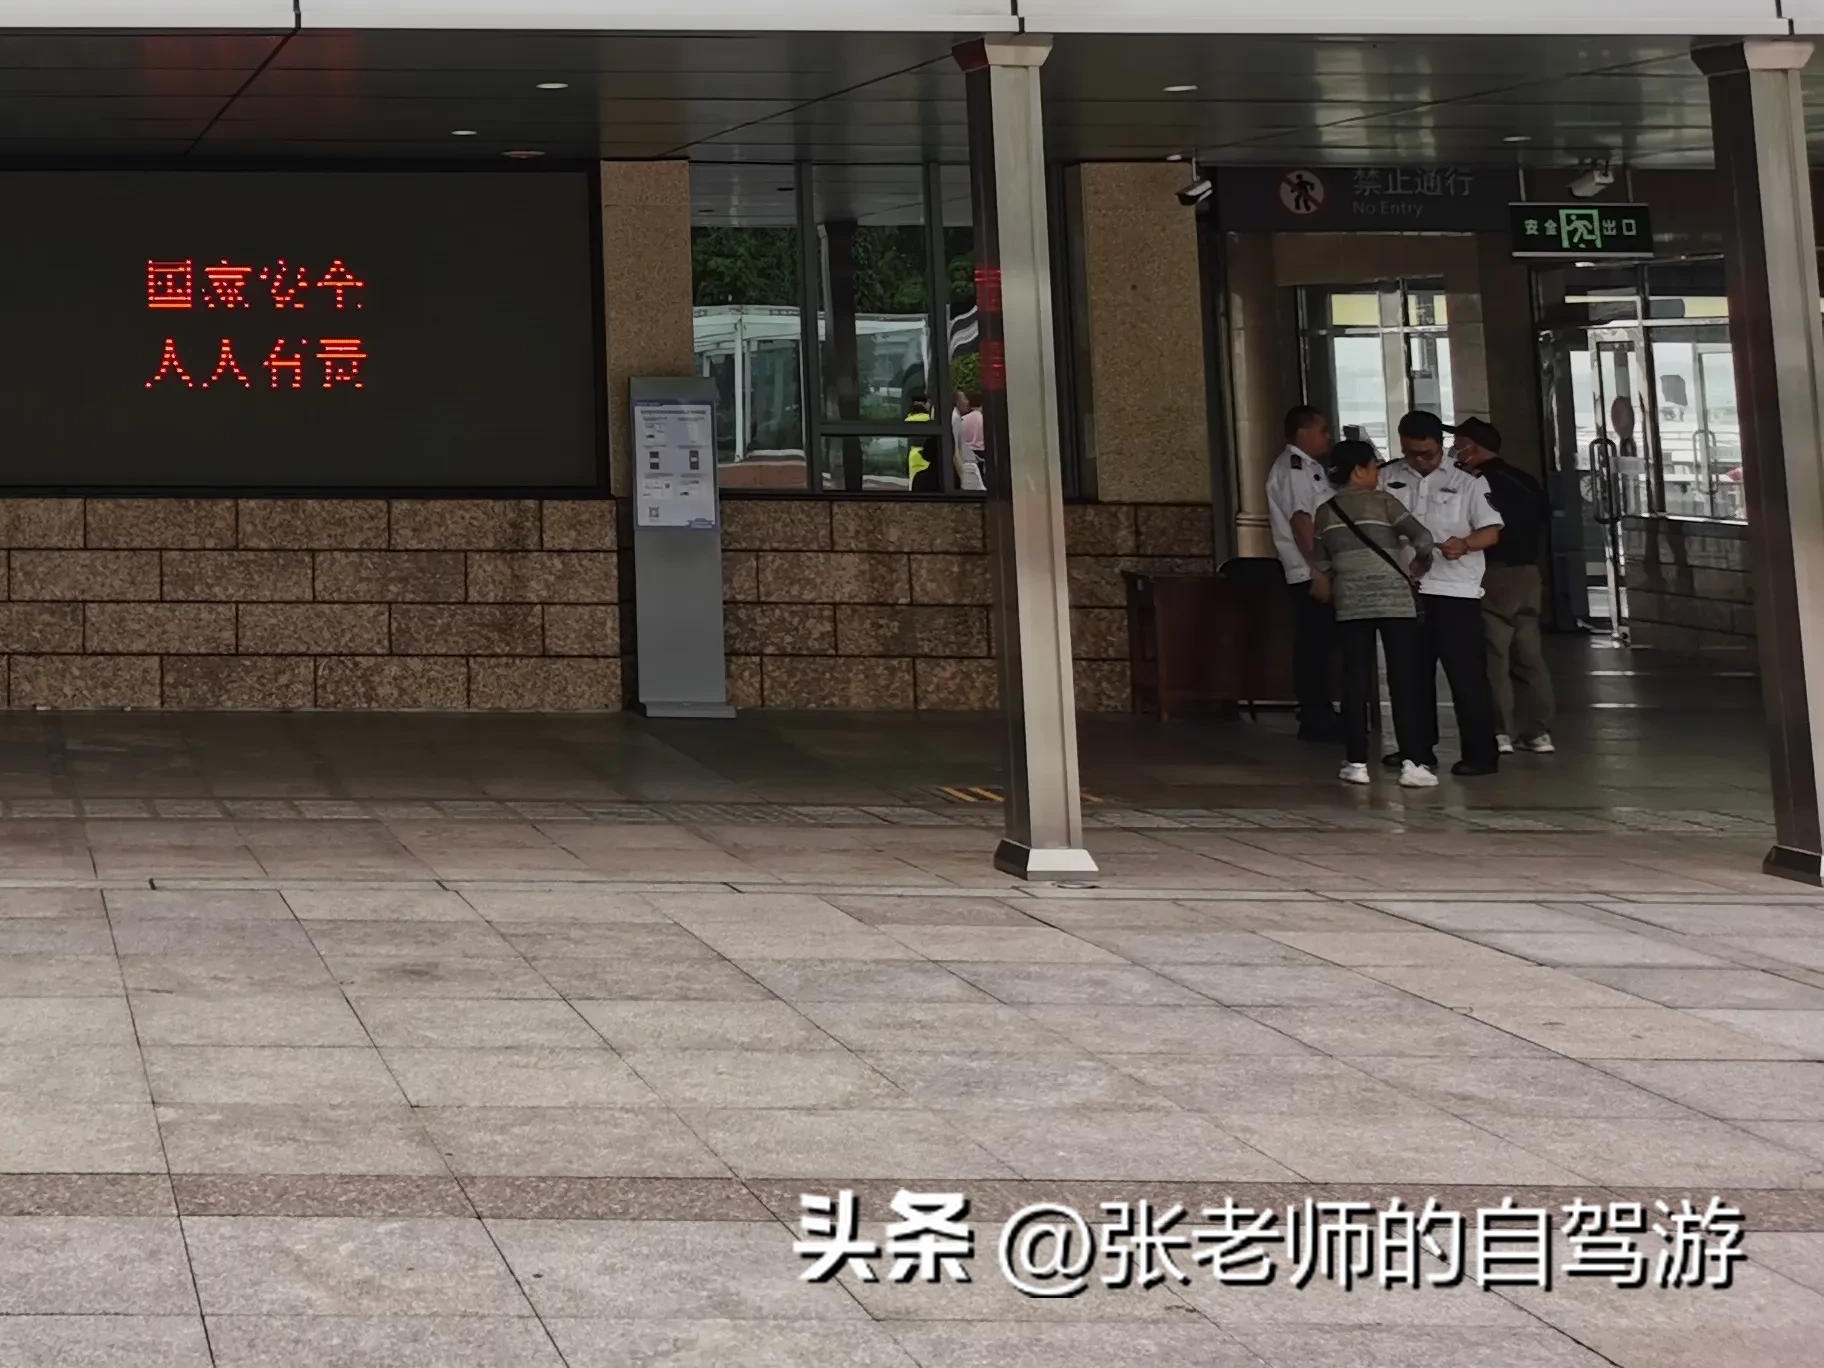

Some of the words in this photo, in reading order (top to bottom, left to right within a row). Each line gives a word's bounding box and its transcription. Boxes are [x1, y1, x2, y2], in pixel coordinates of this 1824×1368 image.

[1351, 167, 1474, 196] 禁止通行
[1352, 200, 1376, 215] No
[1380, 200, 1424, 218] Entry
[1524, 218, 1558, 236] 安全
[1602, 218, 1638, 236] 出口
